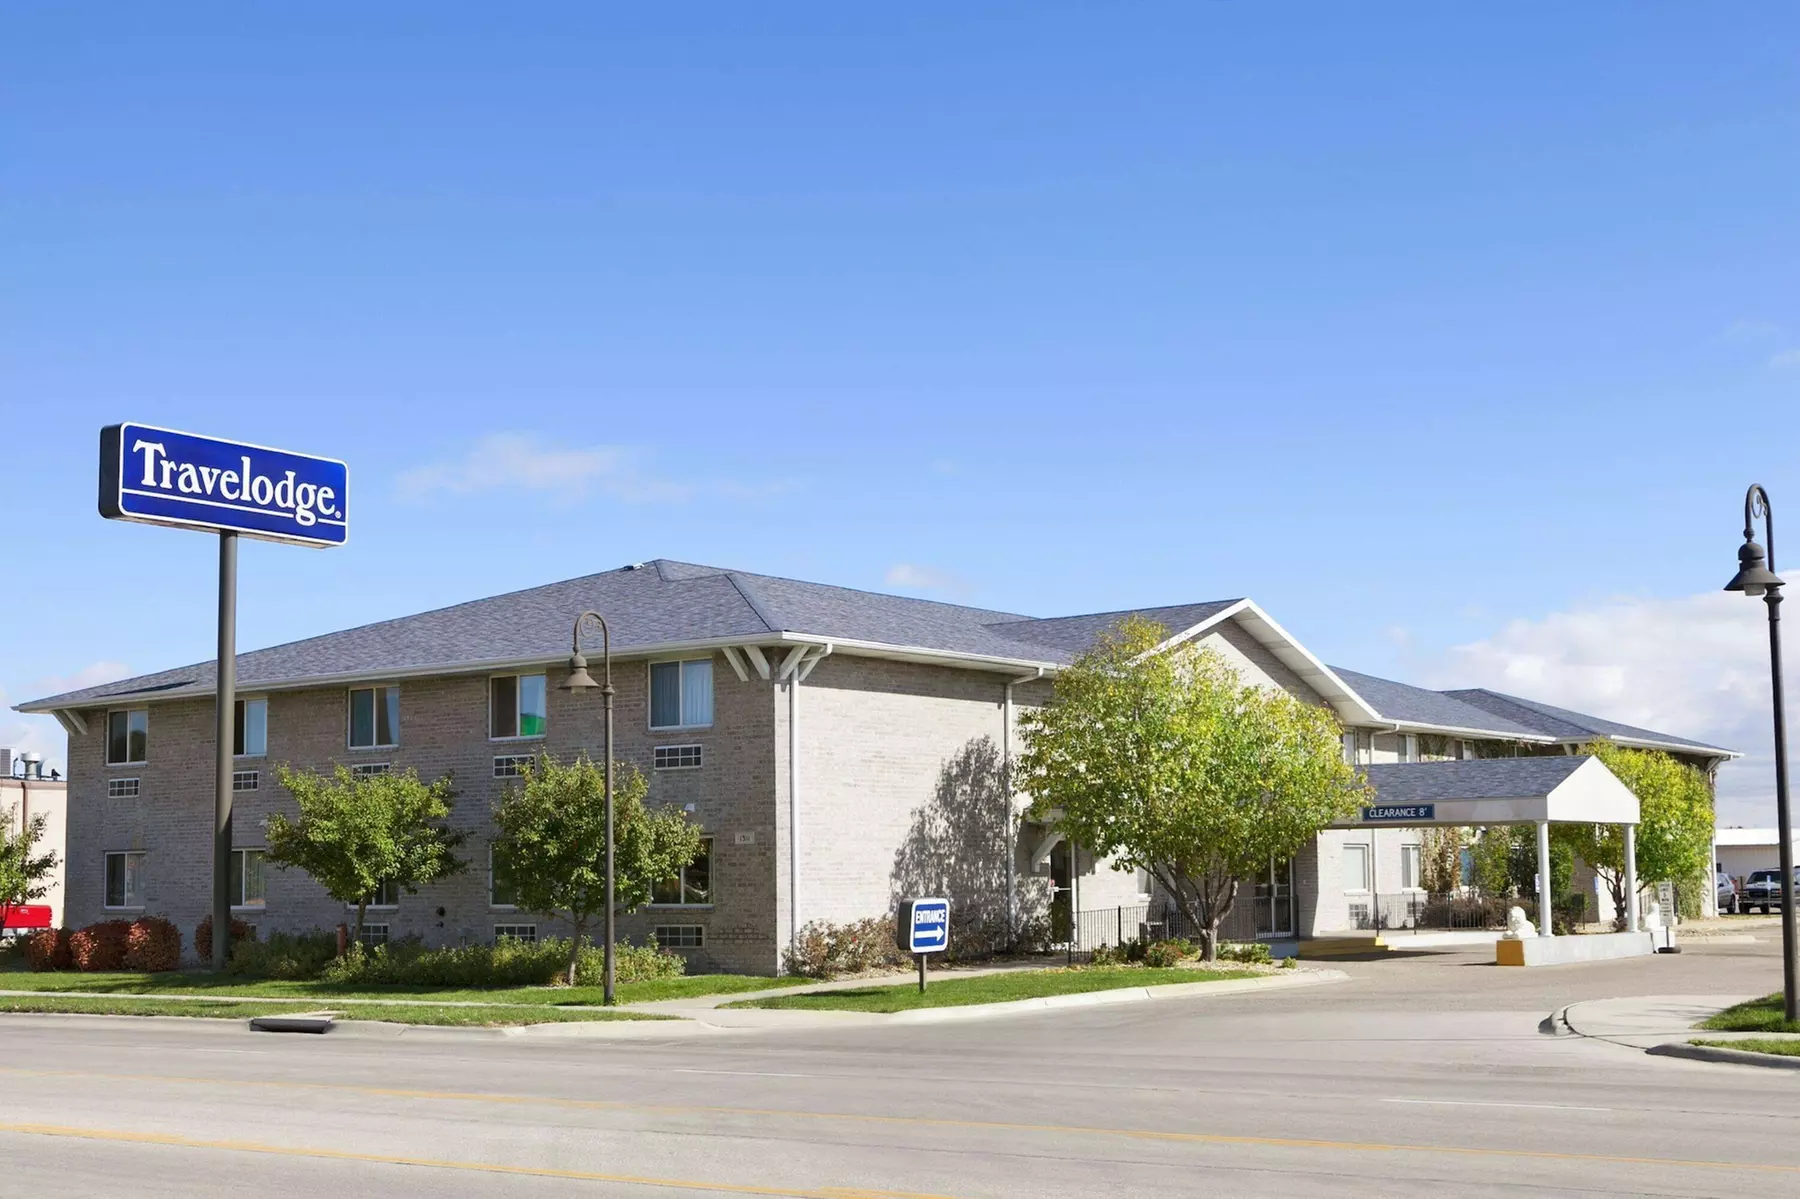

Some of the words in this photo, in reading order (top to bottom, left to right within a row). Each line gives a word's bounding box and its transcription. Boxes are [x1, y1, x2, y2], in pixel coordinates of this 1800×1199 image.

[132, 439, 336, 526] Travelodge
[1369, 808, 1416, 818] CLEARANCE
[915, 909, 946, 924] ENTRANCE
